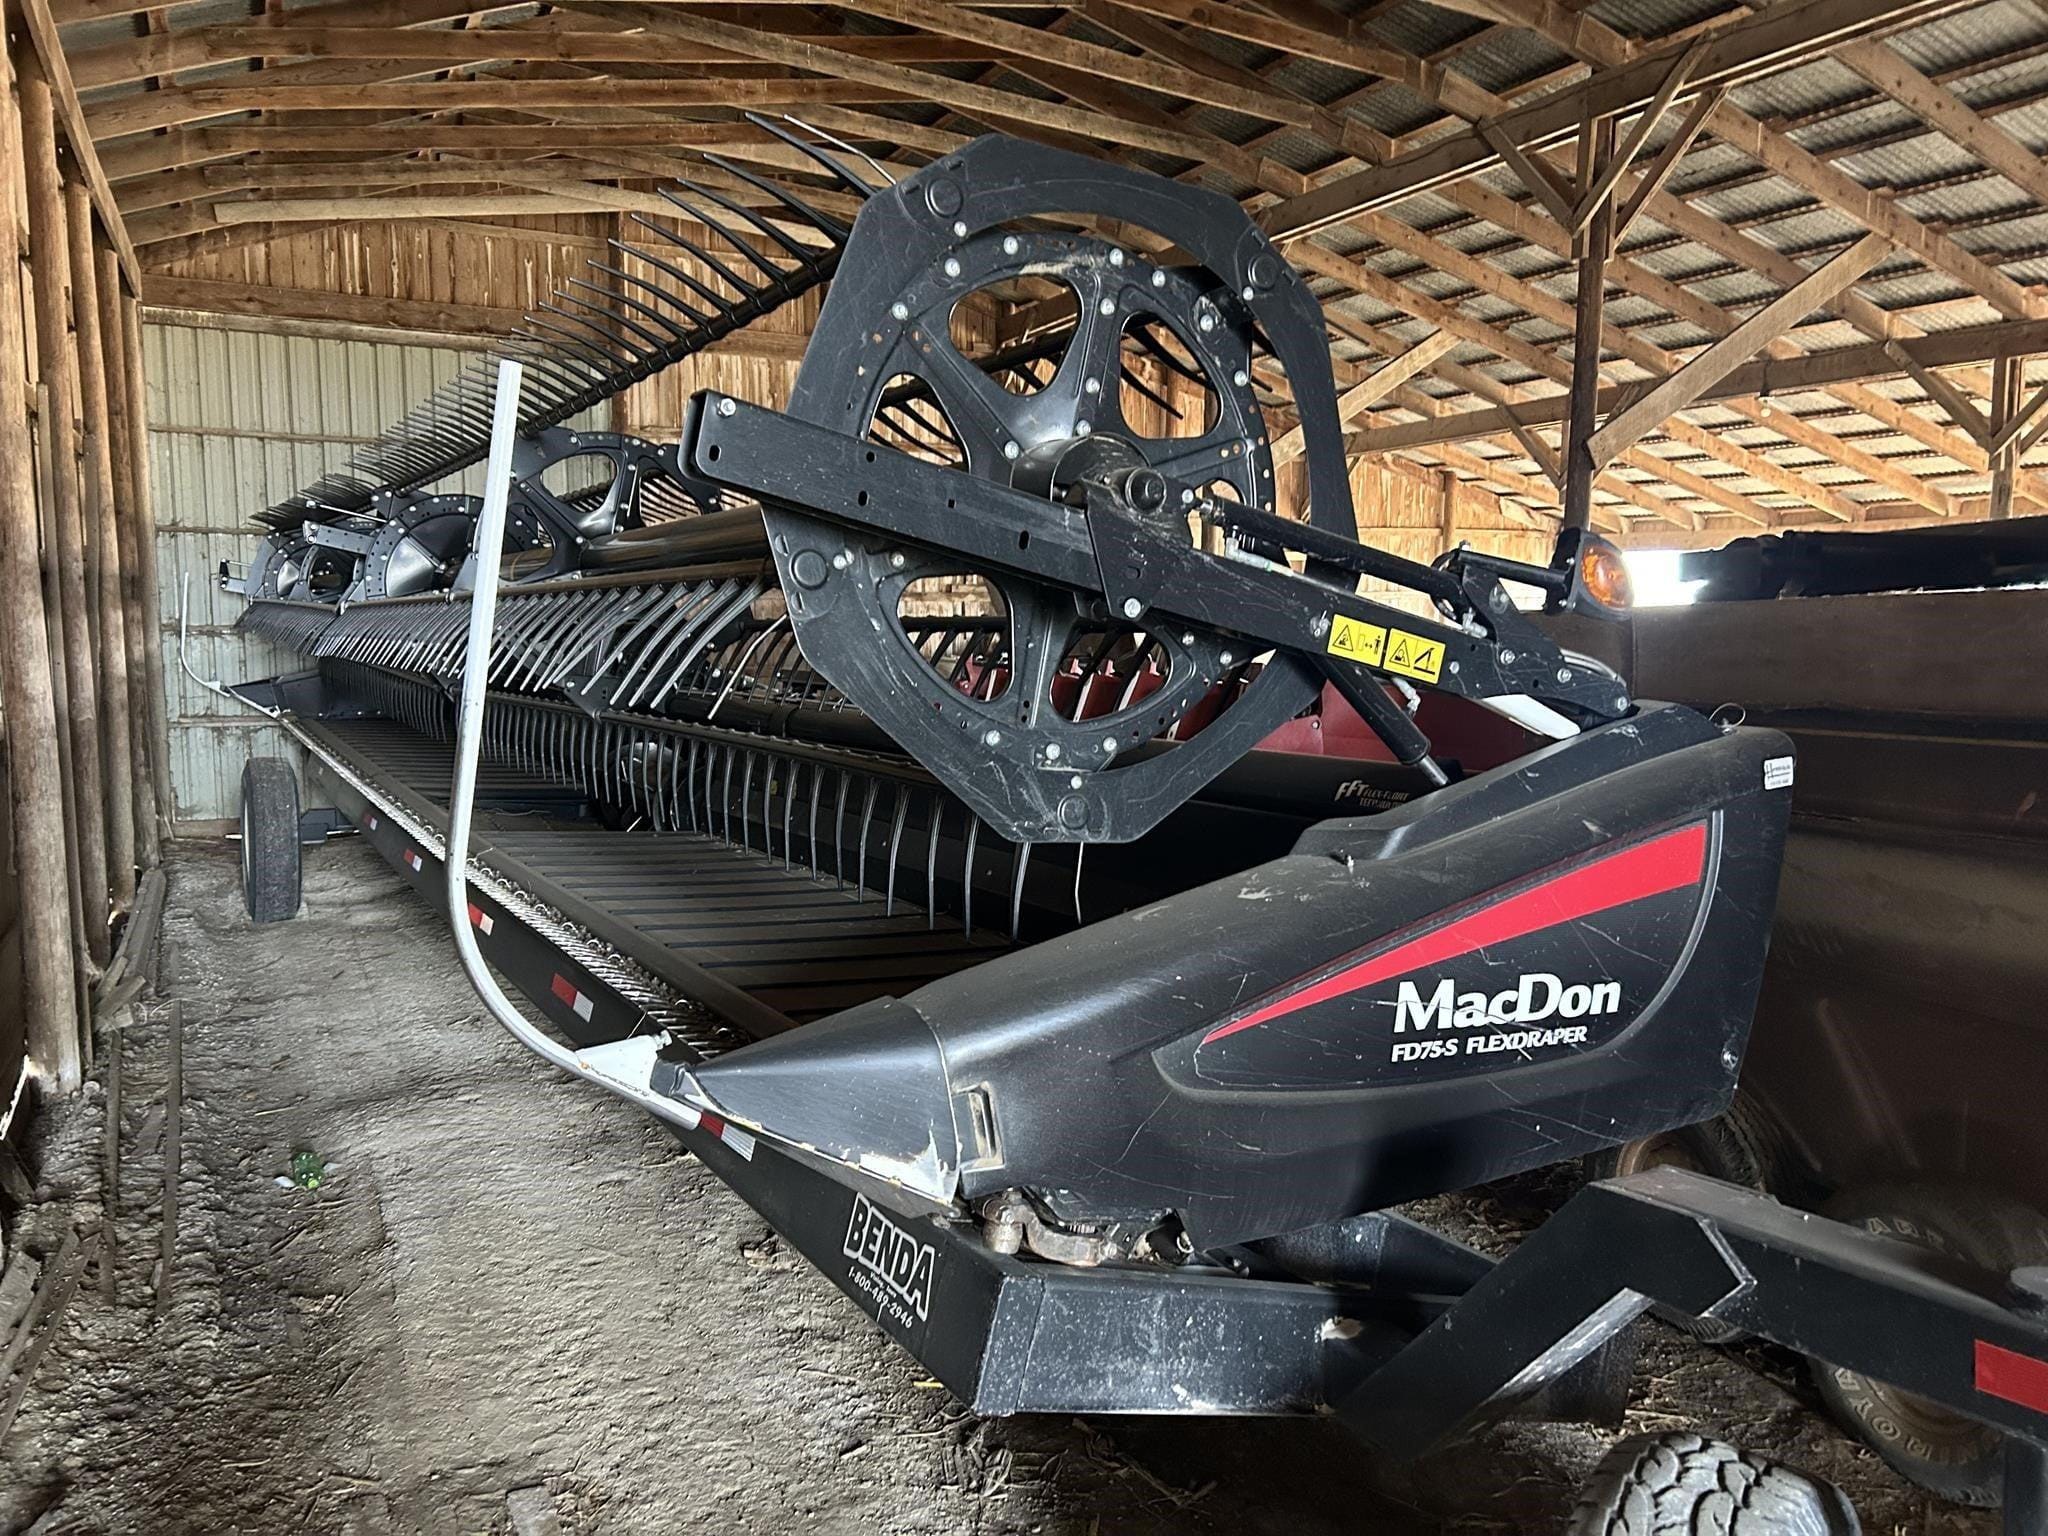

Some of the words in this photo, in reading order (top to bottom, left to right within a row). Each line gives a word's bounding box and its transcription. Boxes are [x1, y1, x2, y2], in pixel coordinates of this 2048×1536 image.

[1393, 973, 1621, 1033] MacDon
[1391, 1038, 1459, 1063] FD75-S
[1466, 1026, 1588, 1055] FLEXDRAPER
[844, 1191, 935, 1322] BENDA
[848, 1266, 914, 1329] 1-800-489-2946
